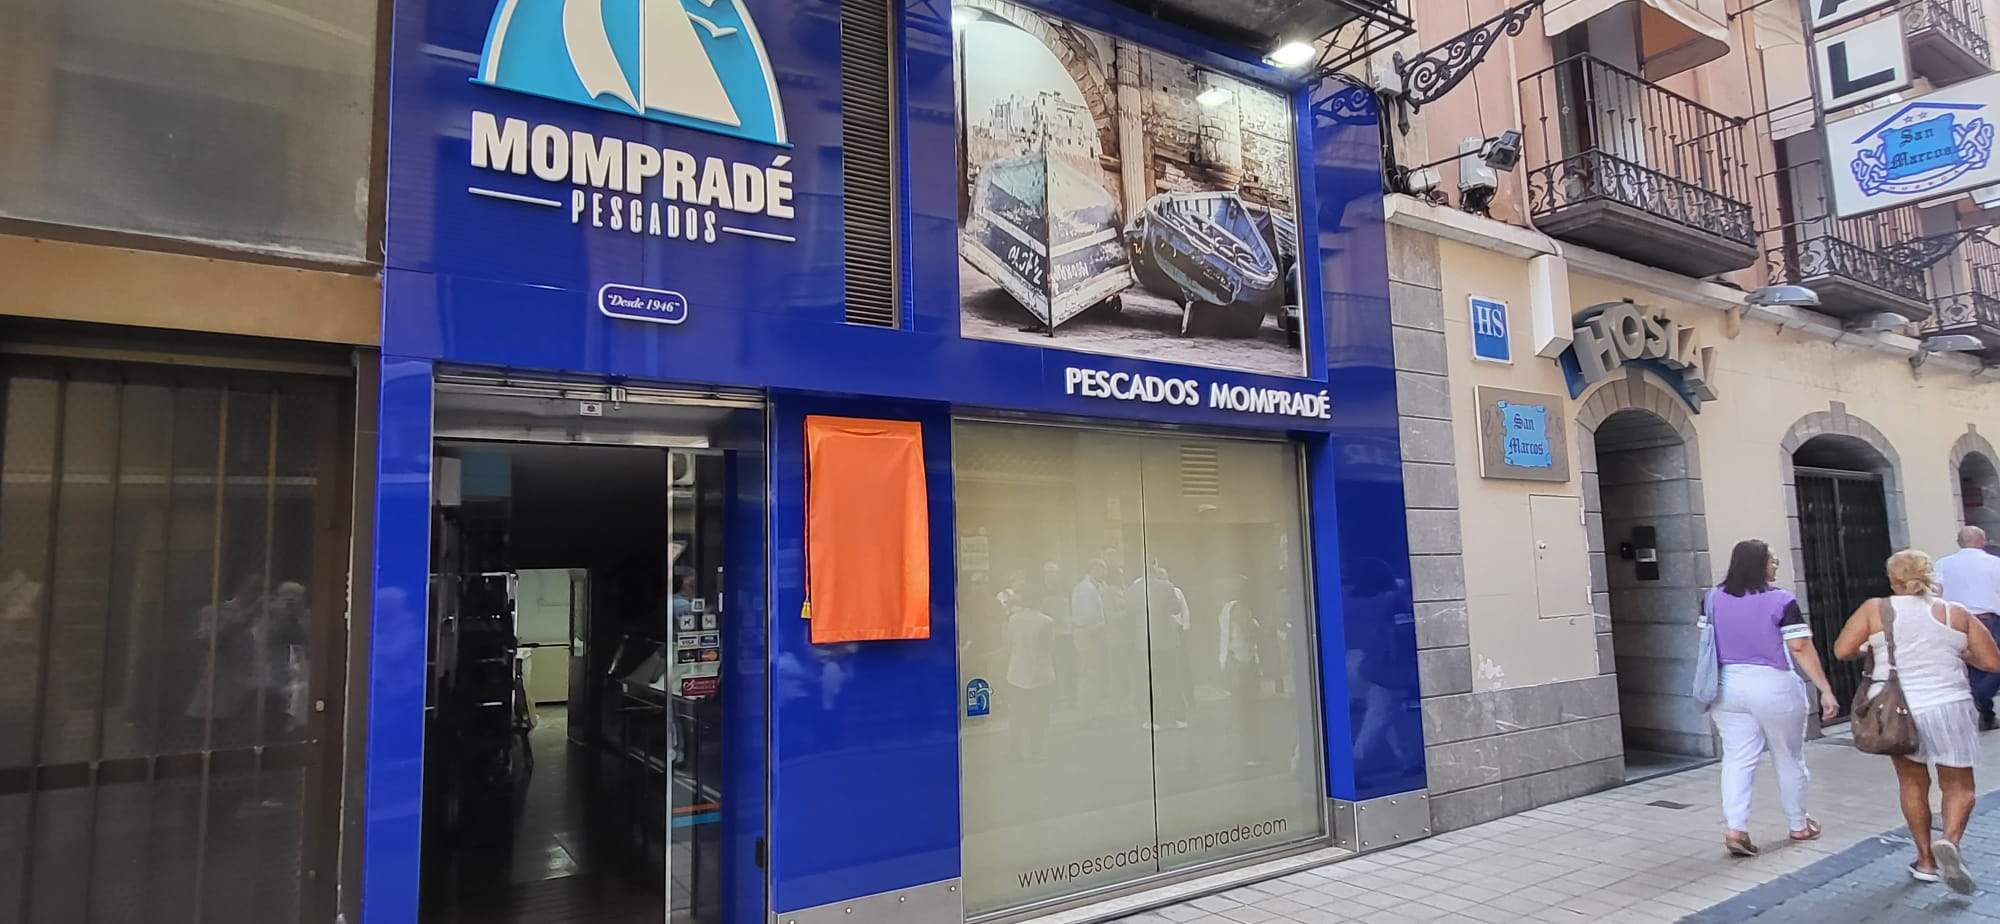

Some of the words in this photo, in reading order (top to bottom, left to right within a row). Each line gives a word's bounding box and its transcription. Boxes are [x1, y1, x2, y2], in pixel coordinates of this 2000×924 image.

[1900, 128, 1934, 147] San
[470, 110, 795, 219] MOMPRADÉ
[1888, 146, 1953, 169] Marcos
[571, 189, 717, 244] PESCADOS
[1476, 305, 1505, 338] HS
[1065, 367, 1199, 406] PESCADOS
[1209, 382, 1332, 419] MOMPRADÉ
[1512, 413, 1535, 431] San
[1508, 437, 1544, 455] Marcos
[1017, 816, 1288, 889] www.pescadosmomprade.com
